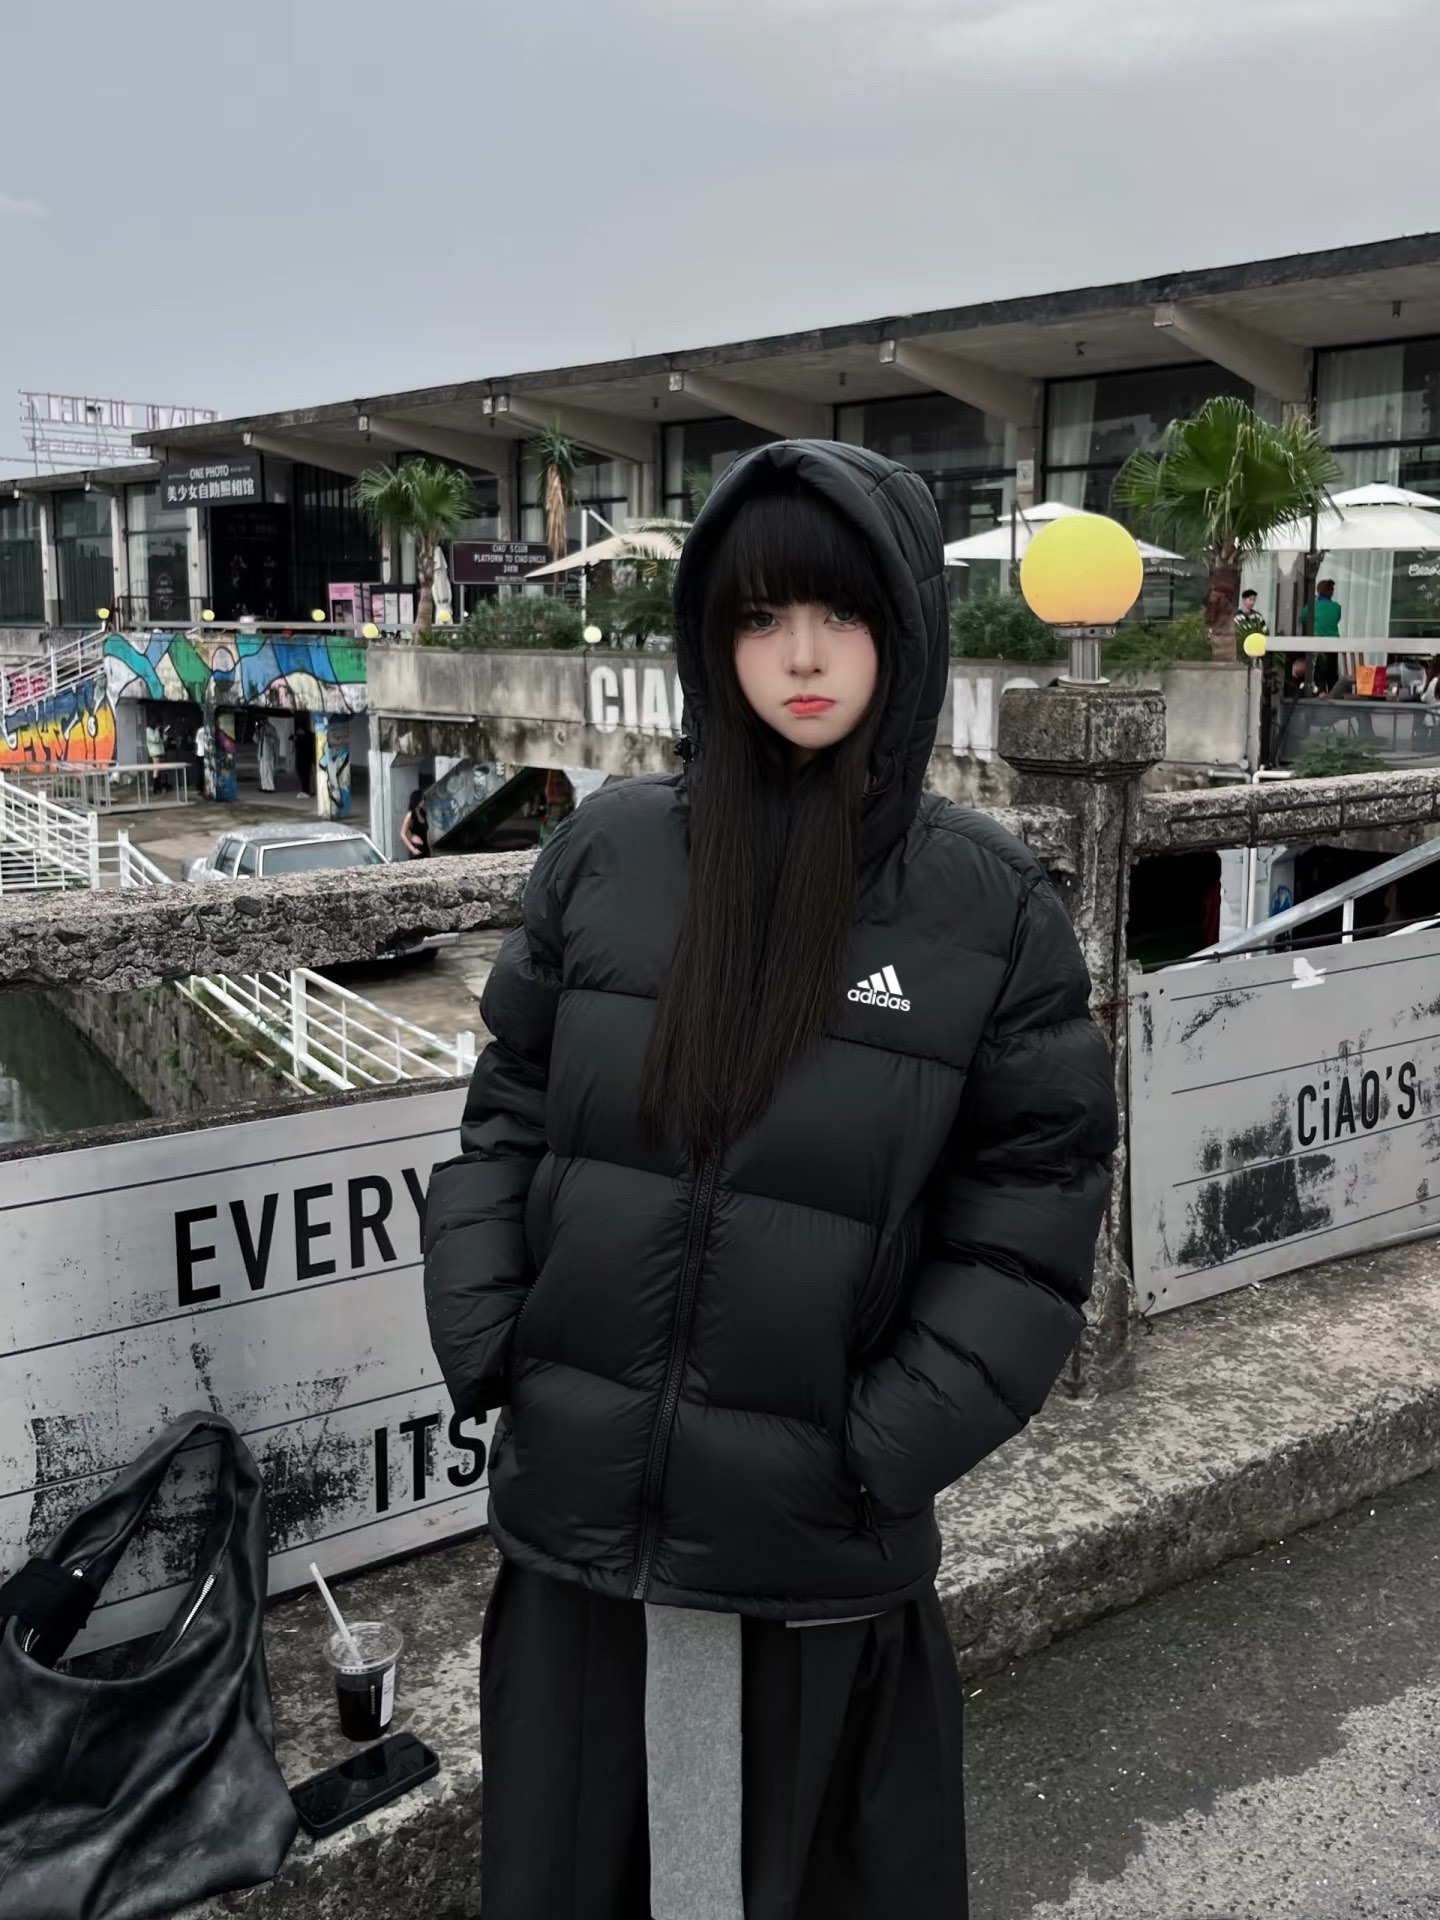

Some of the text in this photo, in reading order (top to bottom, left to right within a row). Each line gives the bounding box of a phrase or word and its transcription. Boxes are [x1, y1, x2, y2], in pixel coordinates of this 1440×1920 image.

[189, 467, 204, 480] ONE
[205, 464, 229, 478] PHOTO
[474, 554, 503, 562] PLATFORM
[505, 555, 513, 563] TO
[847, 988, 911, 1011] adidas
[375, 1405, 487, 1513] ITS
